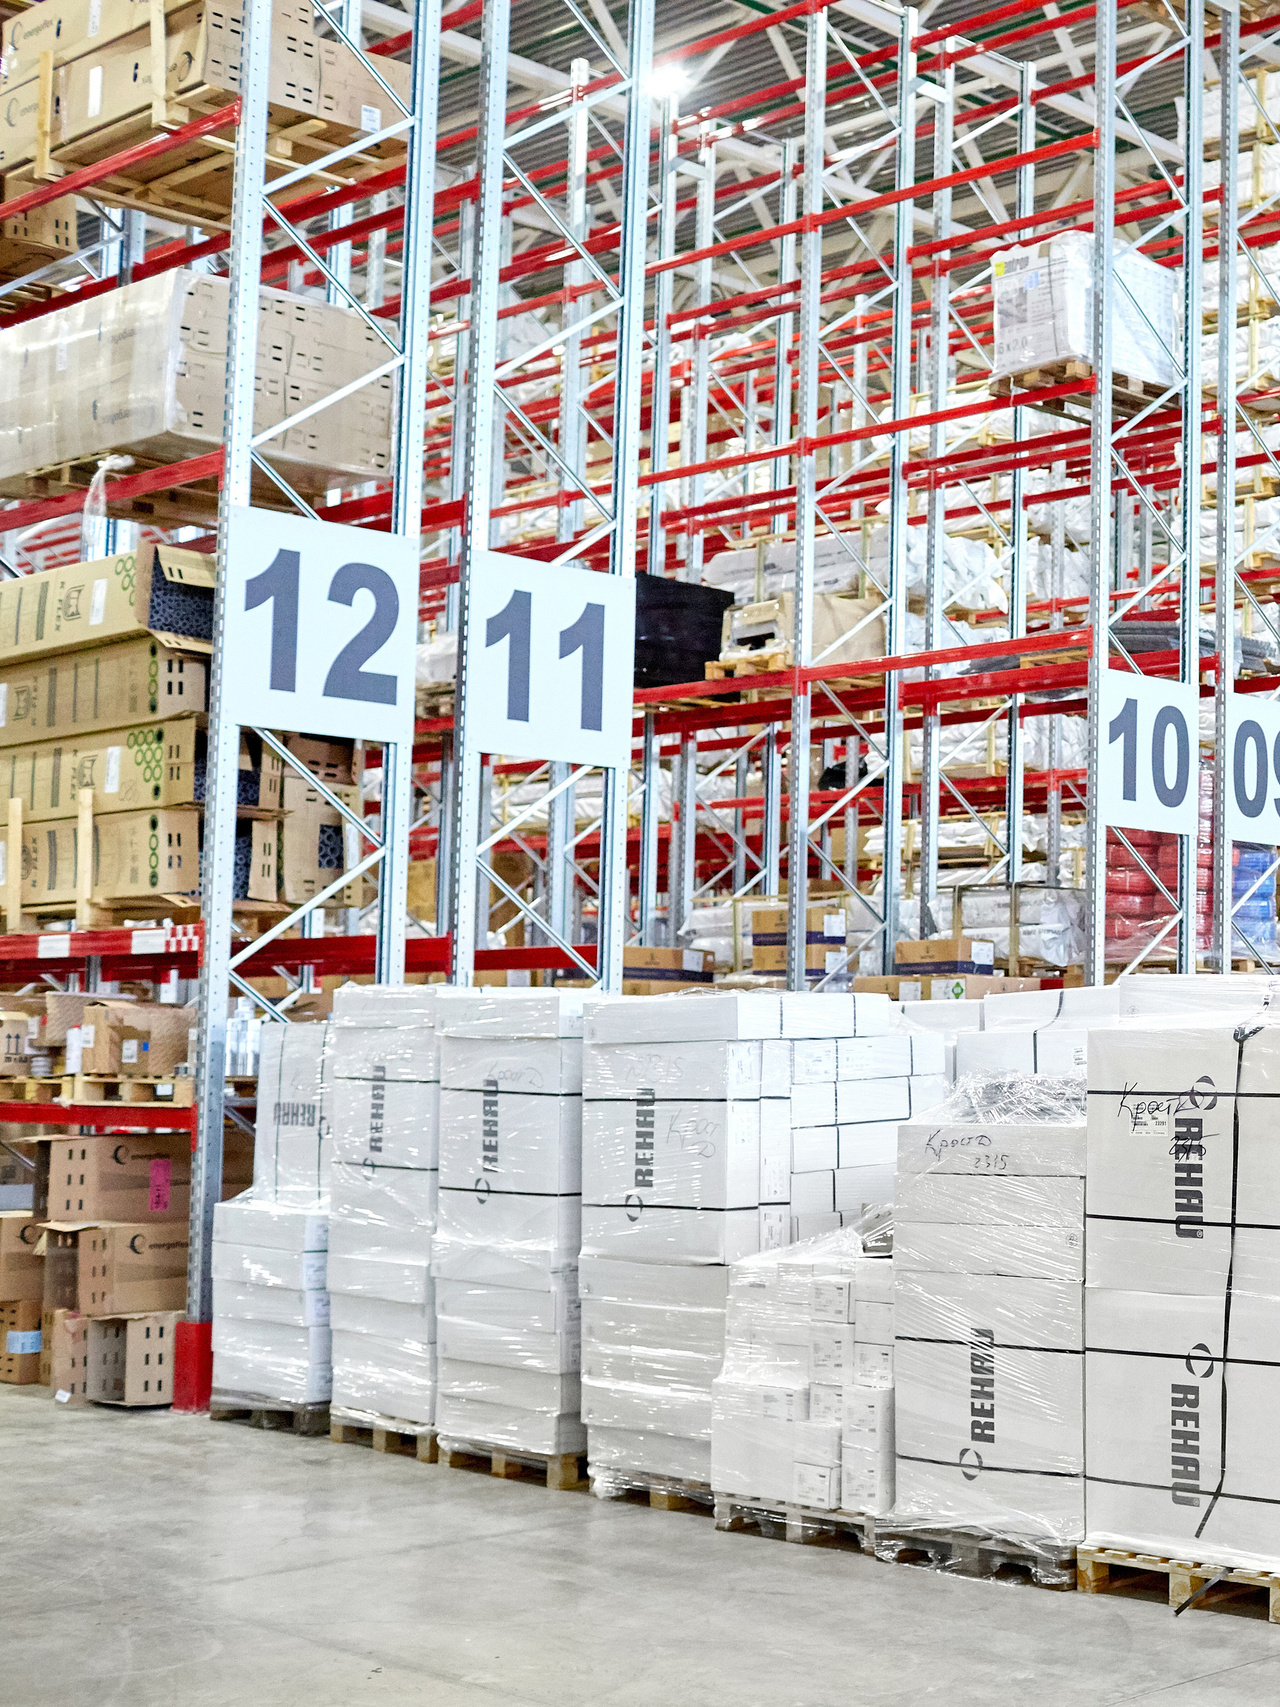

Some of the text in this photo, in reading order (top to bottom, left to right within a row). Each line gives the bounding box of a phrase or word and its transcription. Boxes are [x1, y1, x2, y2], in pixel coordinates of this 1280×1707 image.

[245, 549, 400, 706] 12
[486, 590, 605, 732] 11
[1108, 697, 1190, 808] 10
[483, 1079, 499, 1172] REHAU
[634, 1088, 655, 1187] REHAU
[973, 1154, 1009, 1170] 2315
[1168, 1133, 1220, 1163] 2315
[1175, 1118, 1203, 1239] REHAU
[970, 1327, 995, 1443] REHAU
[1171, 1384, 1200, 1508] REHAU
